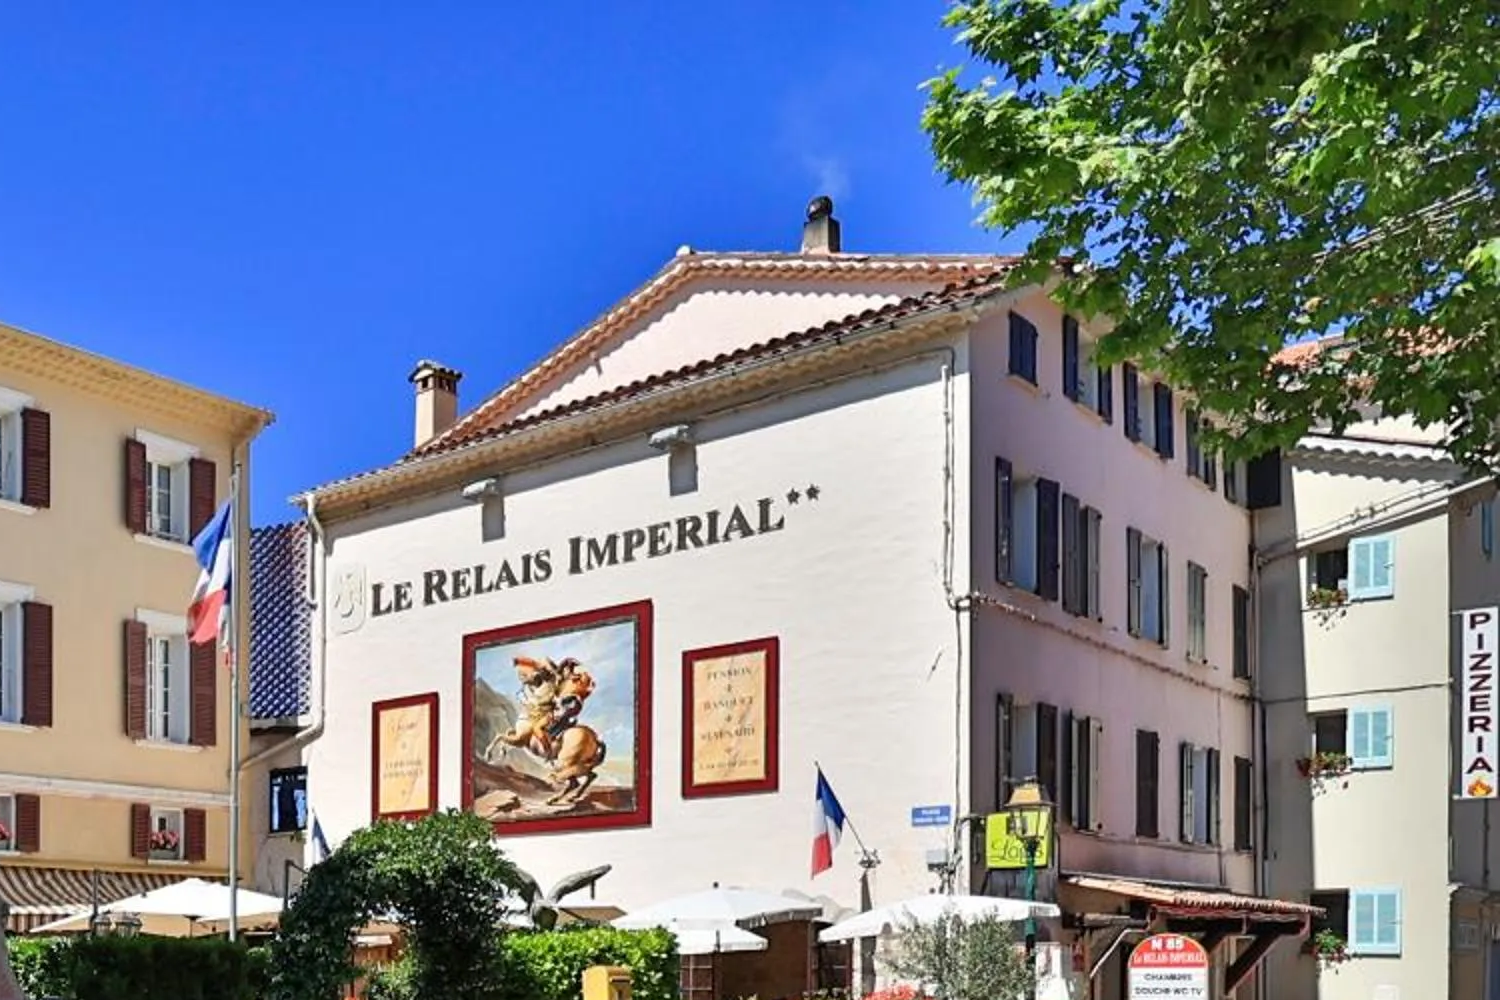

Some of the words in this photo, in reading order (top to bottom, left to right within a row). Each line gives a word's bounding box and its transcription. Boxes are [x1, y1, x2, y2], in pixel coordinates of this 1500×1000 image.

[371, 581, 413, 617] LE
[423, 548, 553, 607] RELAIS
[568, 497, 785, 576] IMPERIAL
[1466, 612, 1494, 775] PIZZERIA
